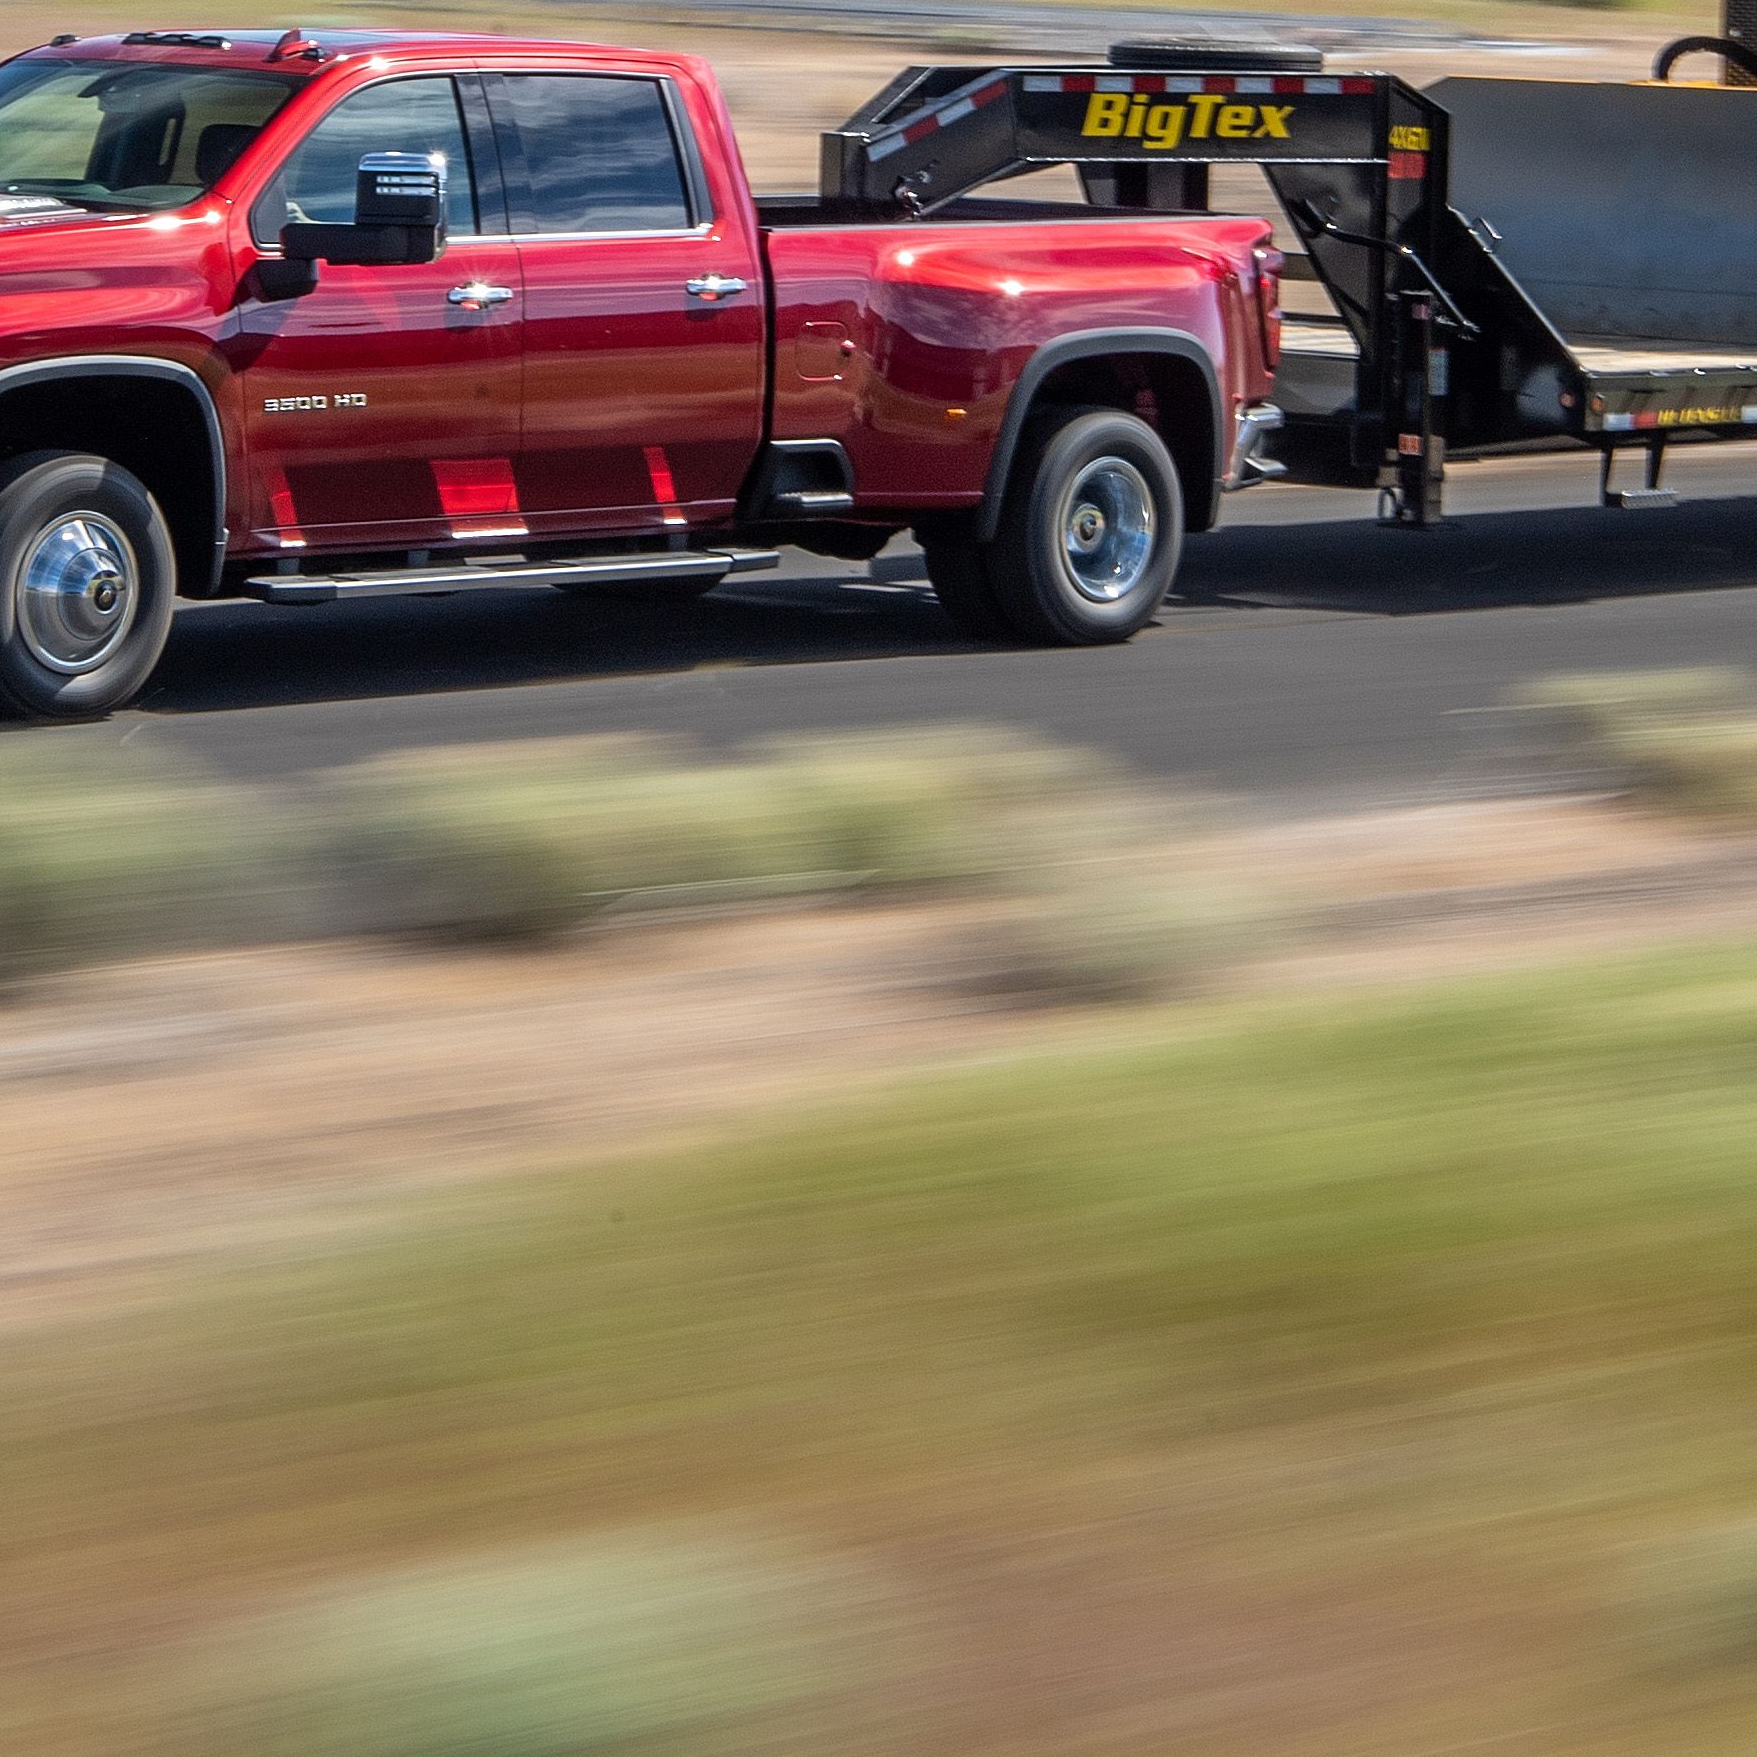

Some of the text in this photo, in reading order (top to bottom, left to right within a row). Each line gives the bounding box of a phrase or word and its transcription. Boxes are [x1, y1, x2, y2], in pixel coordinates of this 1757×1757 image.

[1080, 93, 1296, 150] BigTex
[264, 393, 367, 412] 3500 HD
